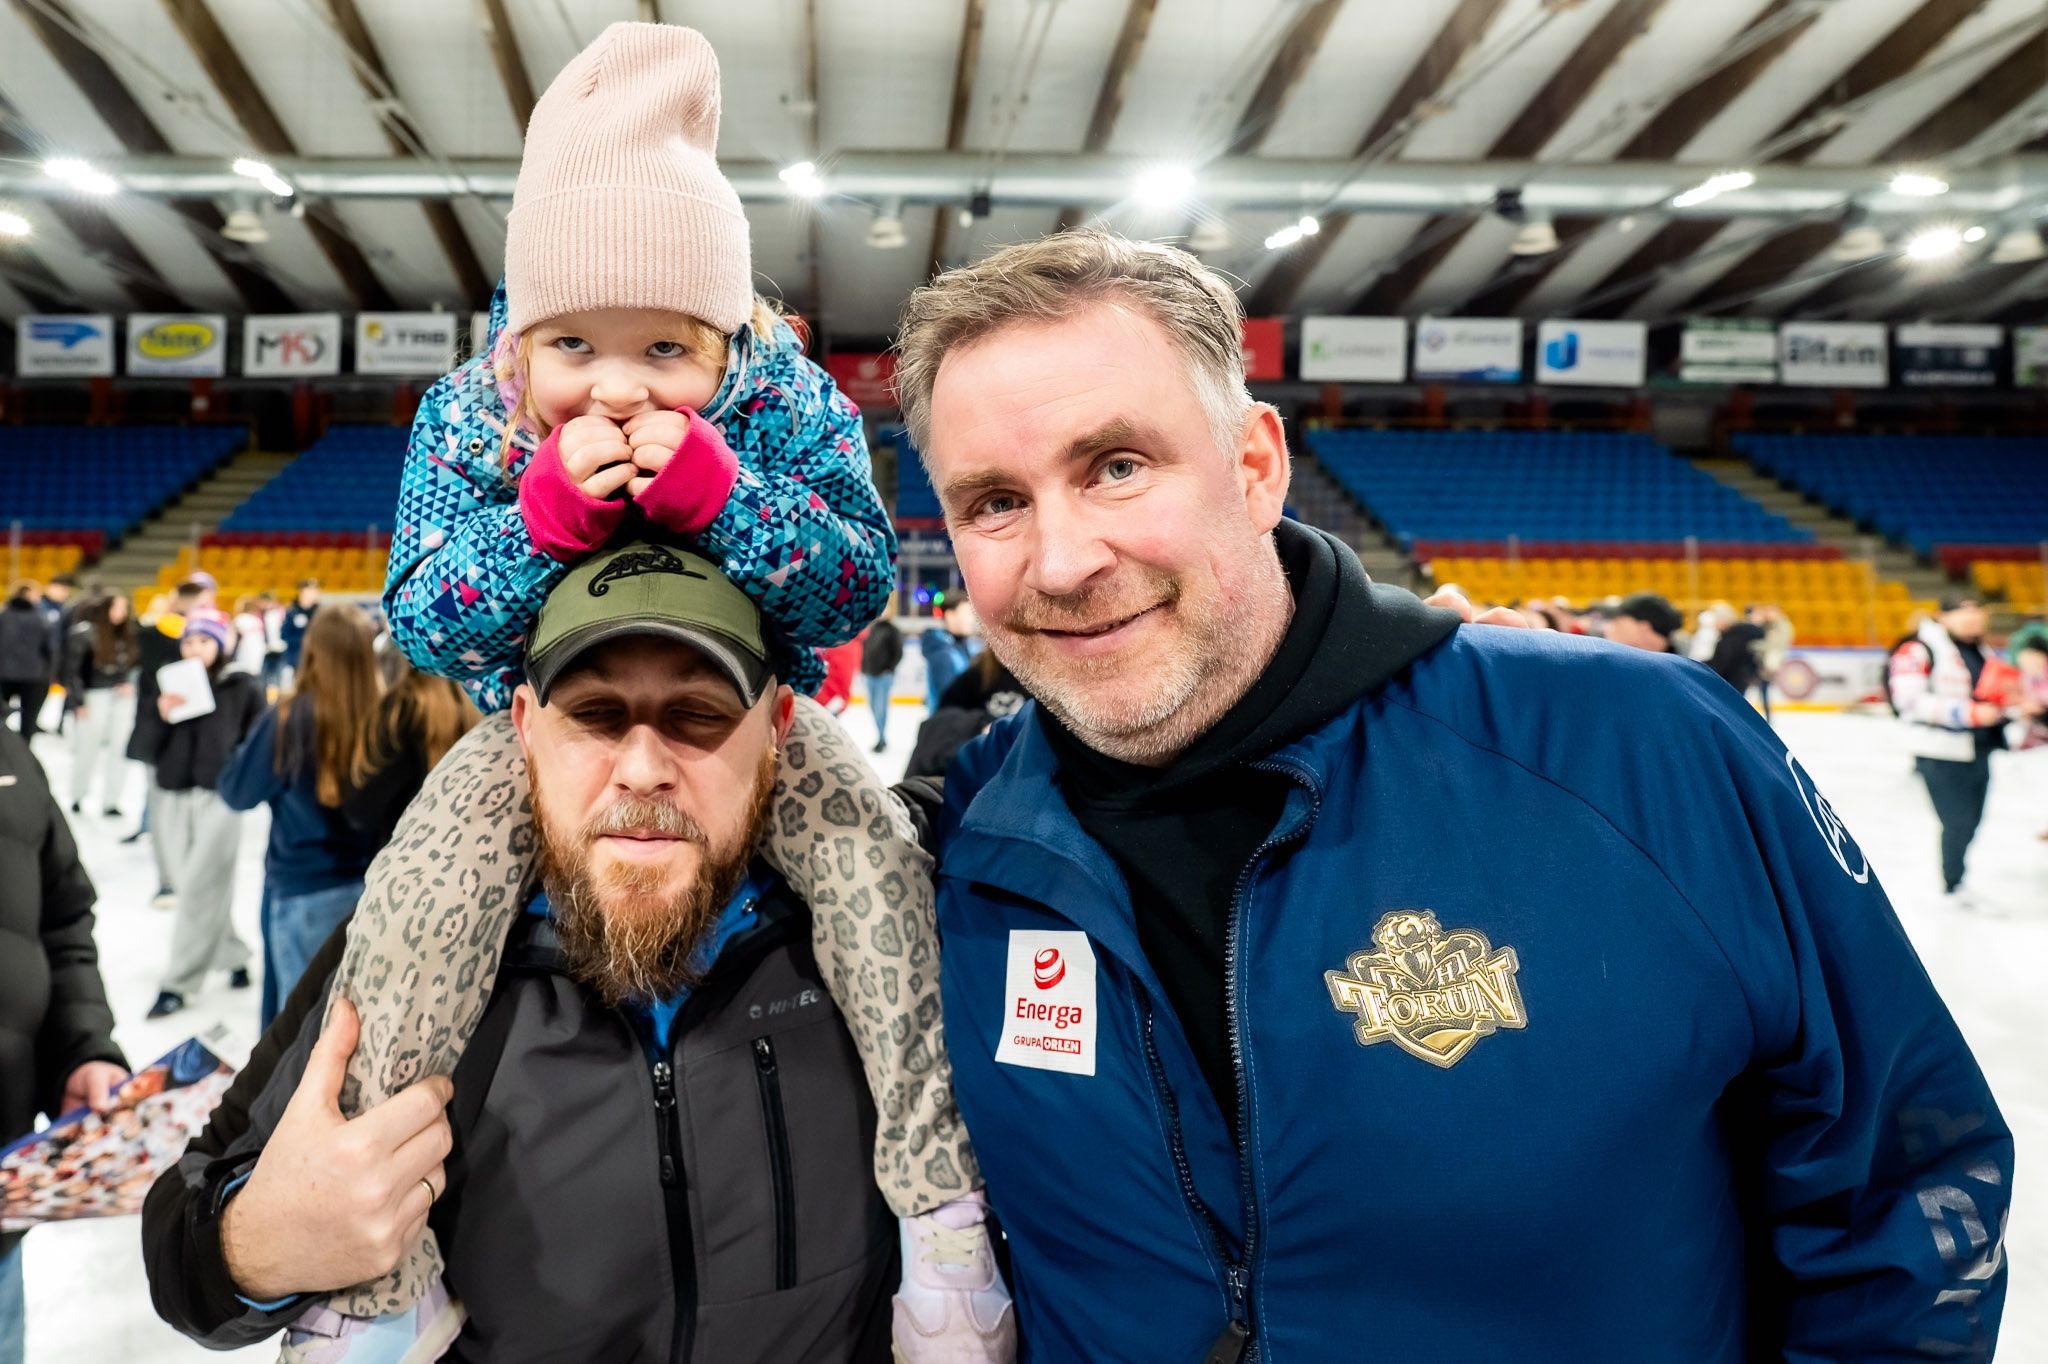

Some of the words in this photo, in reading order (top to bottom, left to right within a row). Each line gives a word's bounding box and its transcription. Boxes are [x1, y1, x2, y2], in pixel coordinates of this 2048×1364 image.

[1016, 997, 1082, 1029] Energa
[1013, 1035, 1042, 1048] GRUPA
[1043, 1038, 1080, 1053] ORLEN
